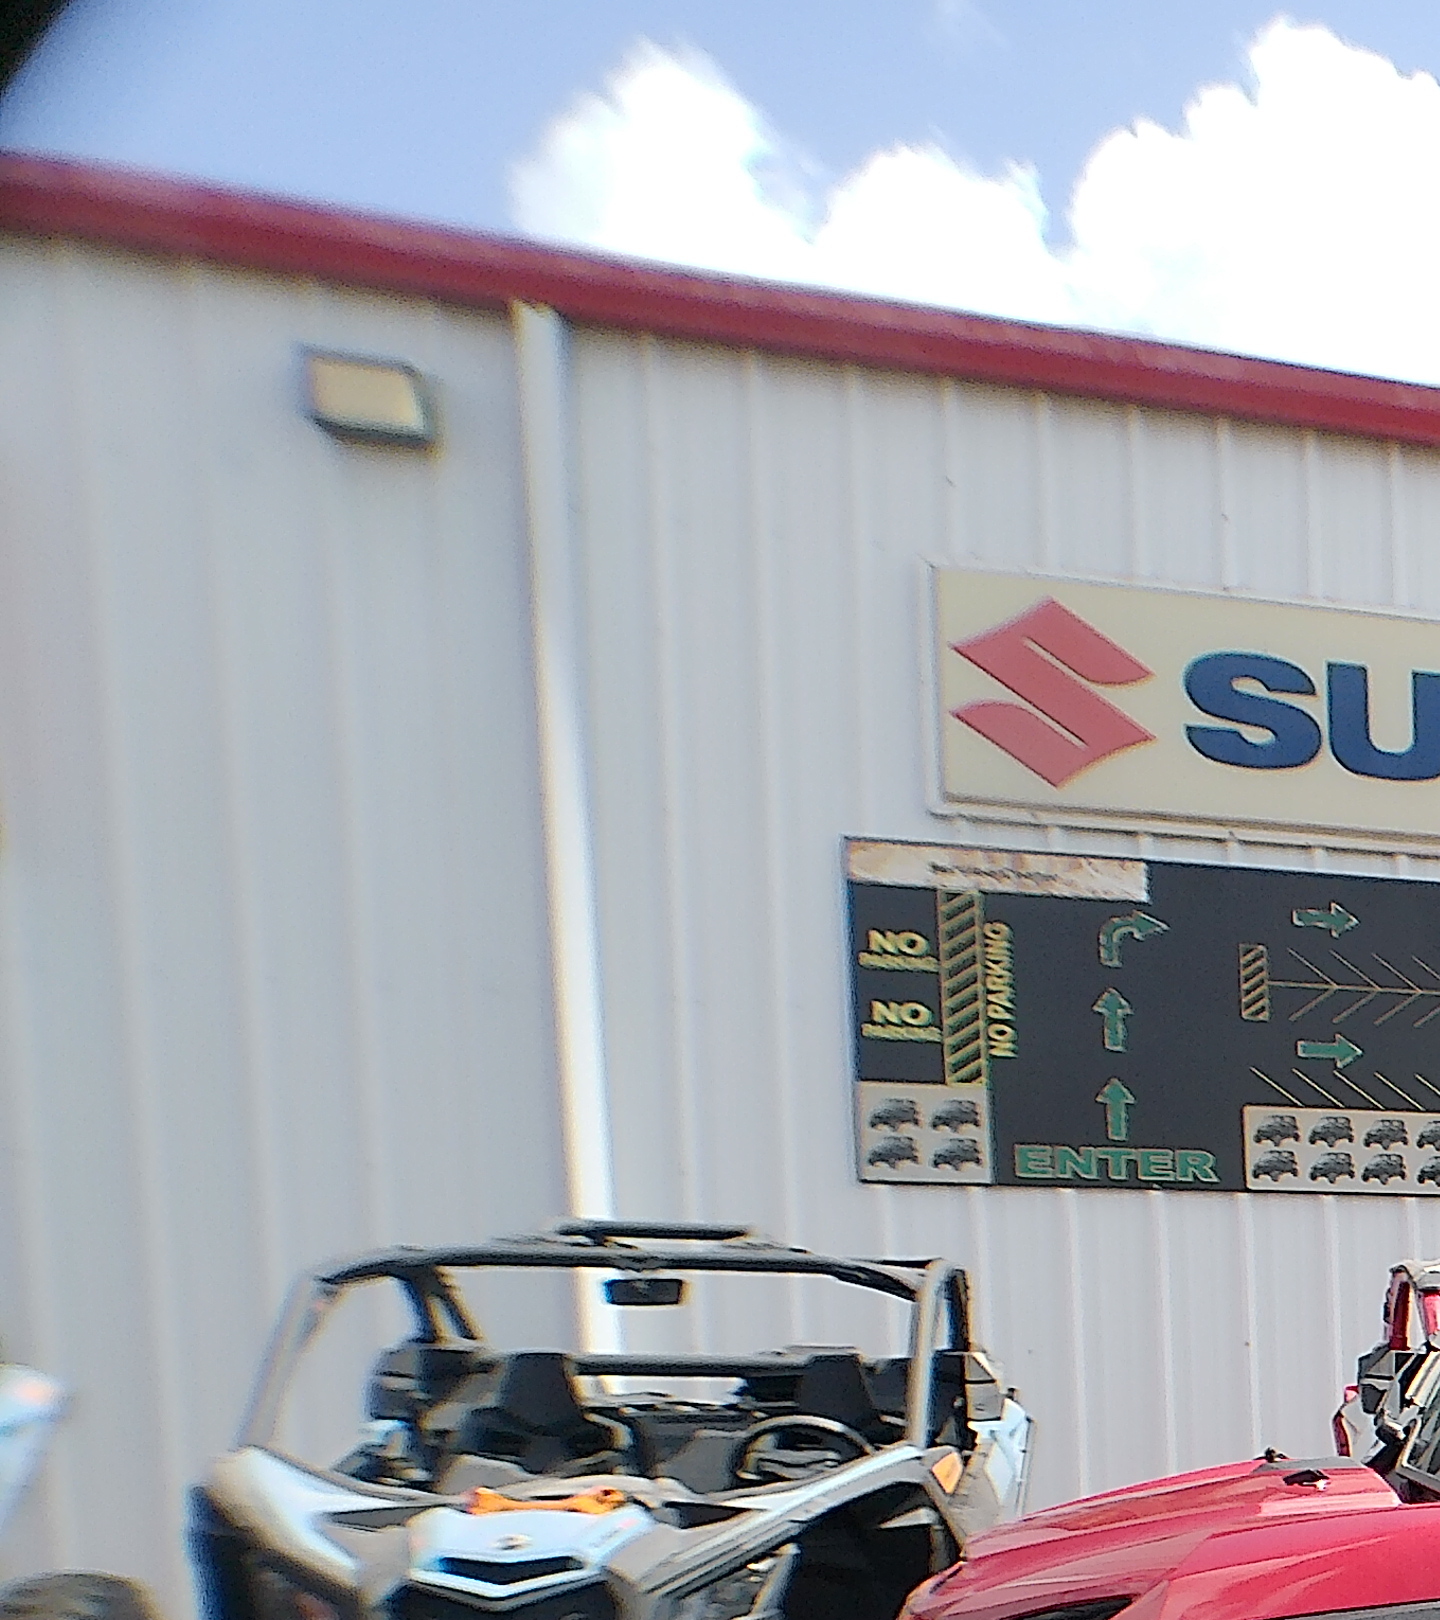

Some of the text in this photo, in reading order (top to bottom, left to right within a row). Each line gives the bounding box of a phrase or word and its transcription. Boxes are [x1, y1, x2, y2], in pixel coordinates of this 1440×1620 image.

[868, 929, 930, 956] NO
[983, 921, 1018, 1058] NO PARKING
[870, 1000, 933, 1026] NO
[1014, 1144, 1220, 1183] ENTER
